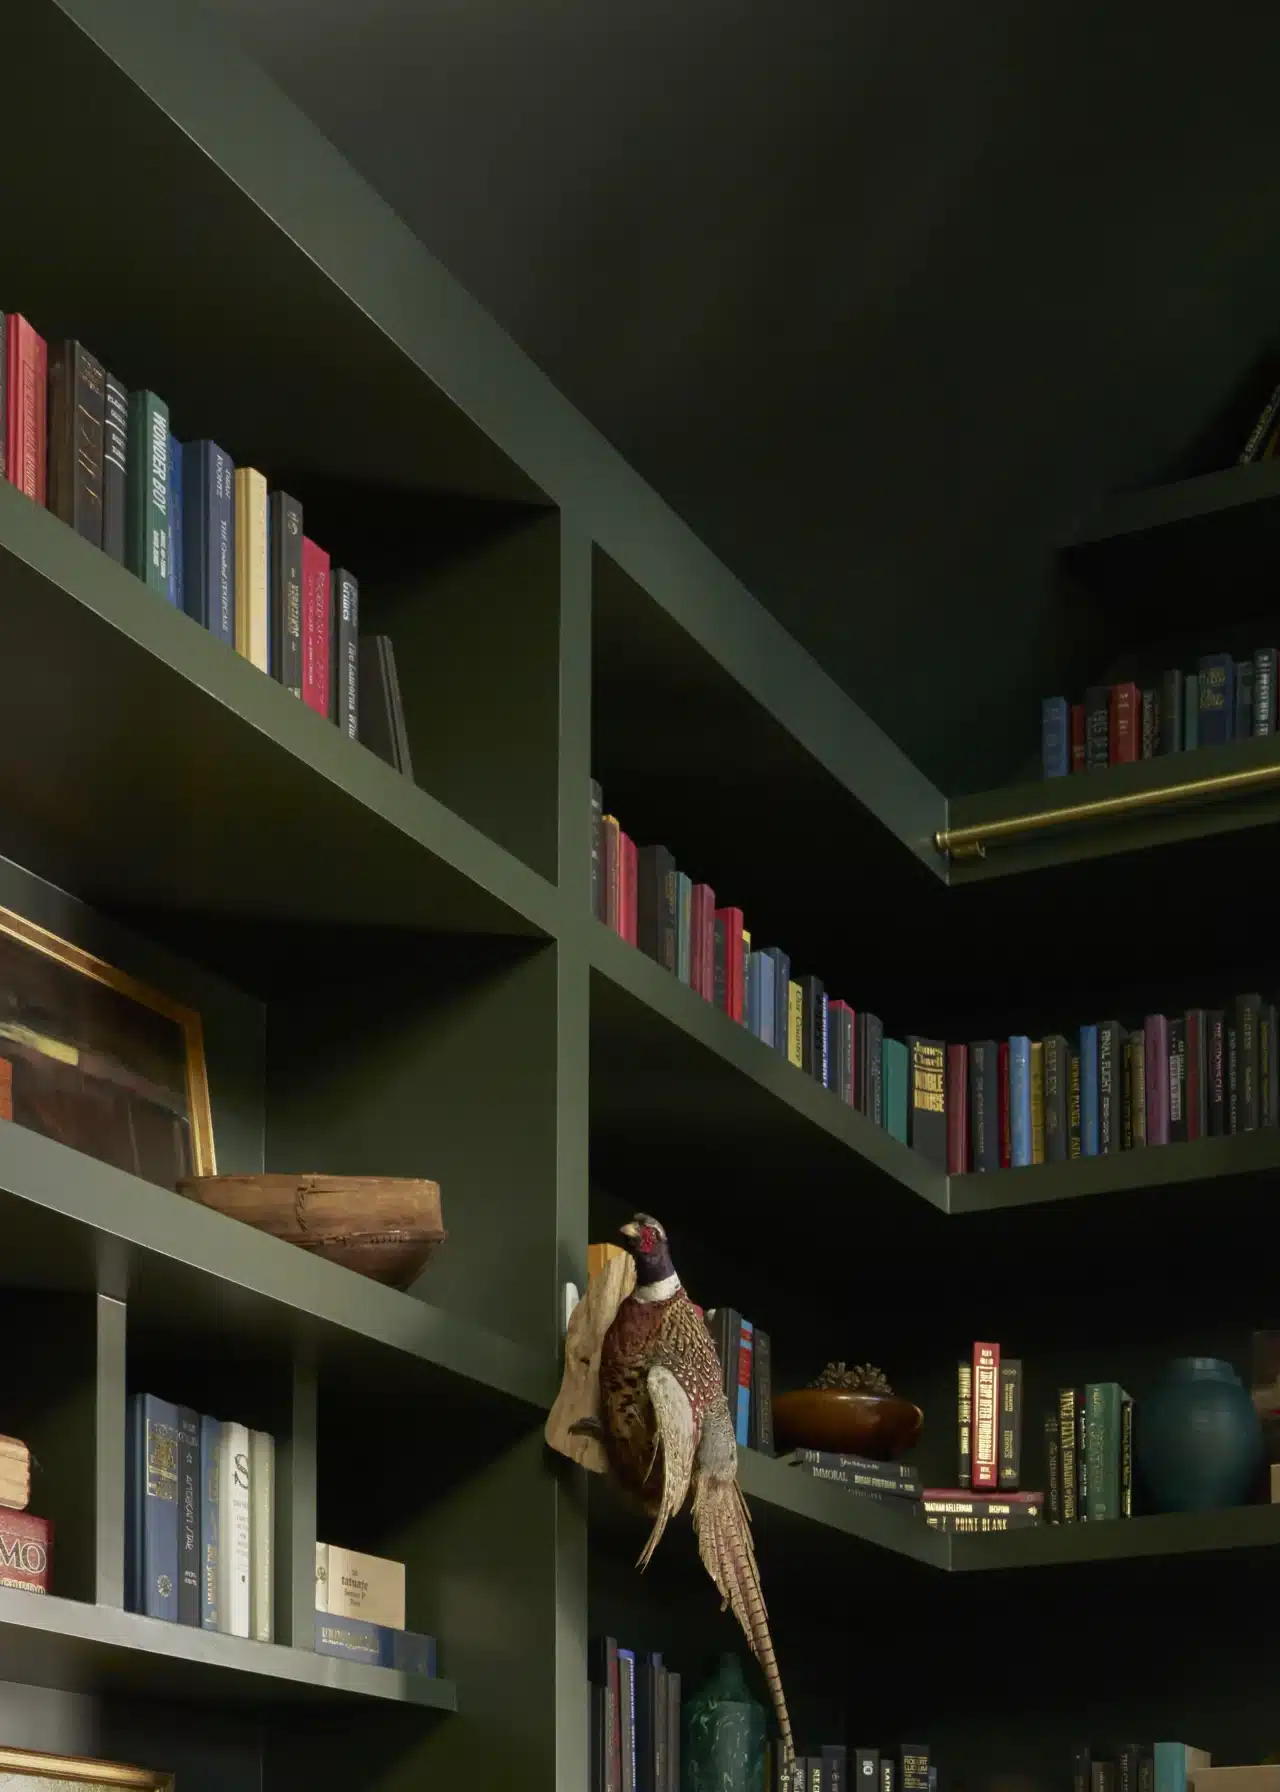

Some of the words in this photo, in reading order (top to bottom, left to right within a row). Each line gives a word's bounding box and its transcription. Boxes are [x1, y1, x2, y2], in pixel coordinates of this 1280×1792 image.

[152, 411, 167, 480] WONDER
[152, 477, 167, 516] BOY
[343, 581, 351, 622] Grimes
[914, 1041, 943, 1056] James
[1101, 1029, 1111, 1059] FINAL
[914, 1052, 943, 1068] Clavell
[914, 1069, 944, 1093] NOBLE
[1101, 1060, 1112, 1094] FLIGHT
[914, 1089, 944, 1112] HOUSE
[958, 1366, 972, 1398] DRIVING
[980, 1383, 993, 1398] DAY
[958, 1400, 972, 1424] FORCE
[979, 1399, 993, 1419] AFTER
[1060, 1391, 1075, 1419] VINCE
[978, 1419, 992, 1460] TOMORROW
[1060, 1420, 1075, 1449] FLYNN
[812, 1466, 849, 1482] IMMORAL
[945, 1503, 973, 1513] KELLERMAN
[988, 1504, 1010, 1514] DECEPTION
[1063, 1494, 1074, 1518] POWER
[955, 1516, 978, 1532] POINT
[980, 1518, 1006, 1532] BLANK
[341, 1576, 369, 1591] tatuaje
[903, 1758, 928, 1766] ROBERT
[812, 1768, 820, 1785] SUE
